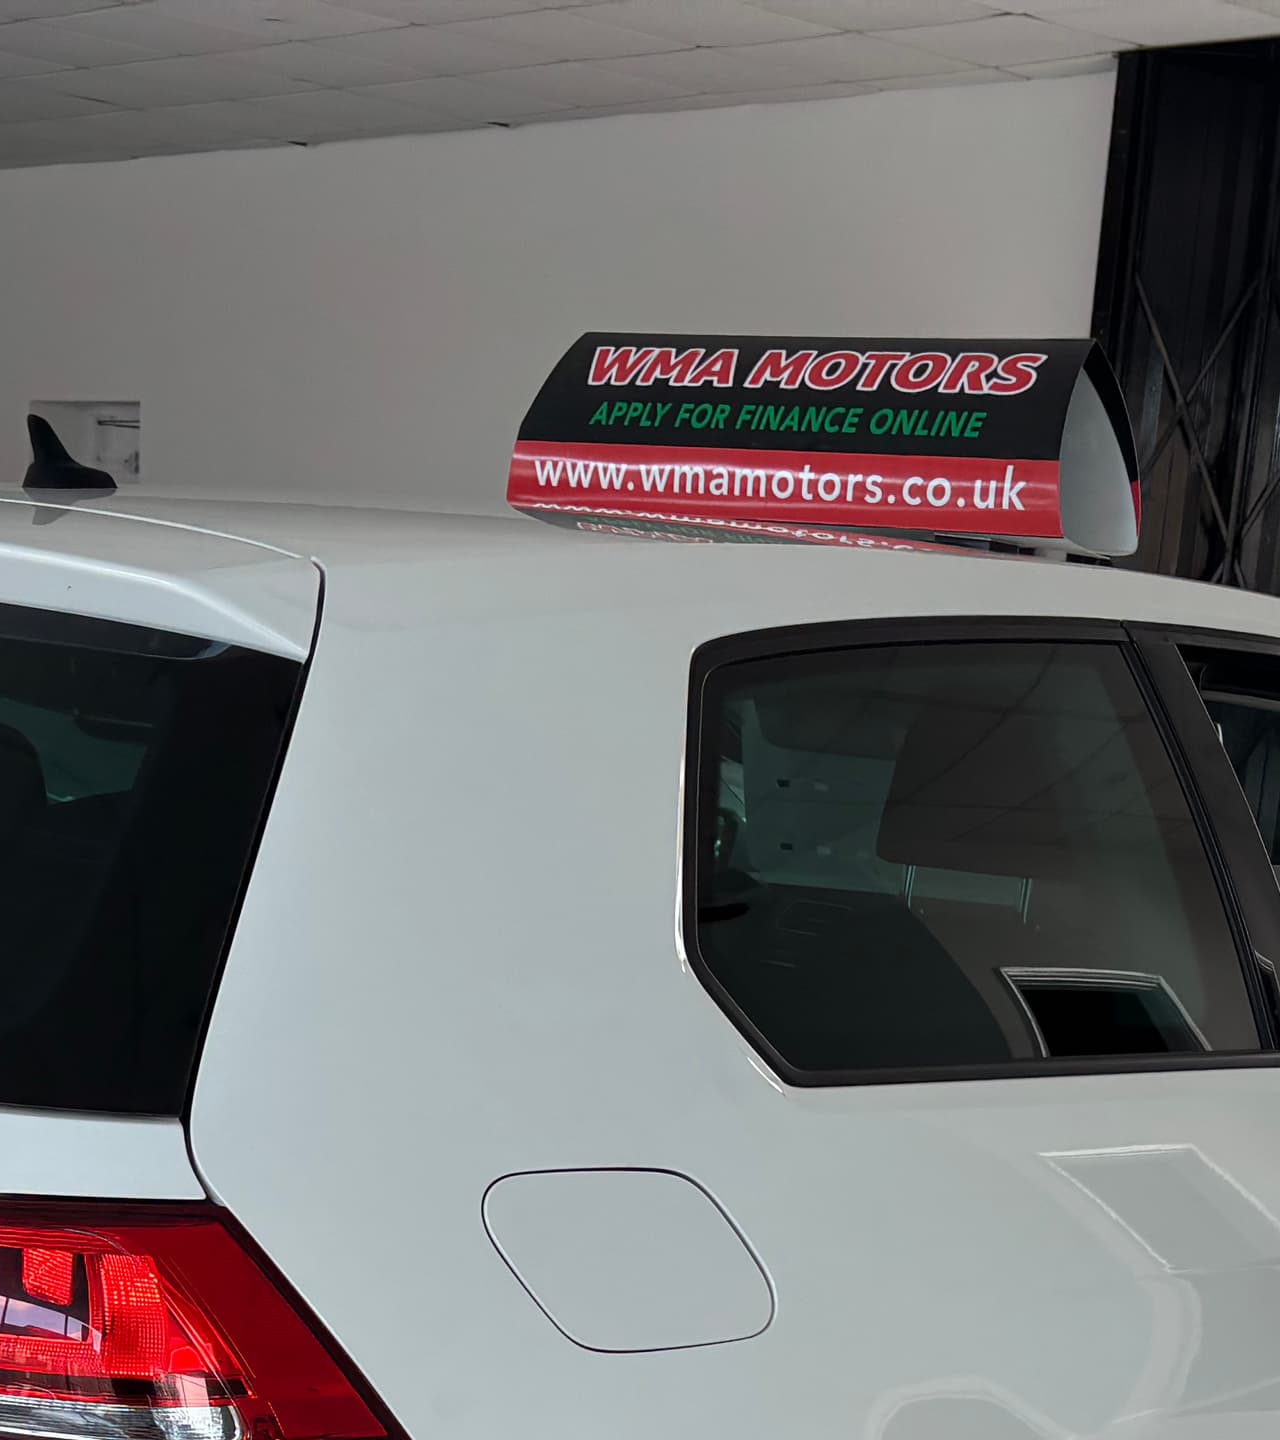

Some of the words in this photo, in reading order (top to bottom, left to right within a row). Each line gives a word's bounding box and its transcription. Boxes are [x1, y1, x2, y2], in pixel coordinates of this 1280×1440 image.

[588, 346, 738, 388] WMA
[743, 350, 1049, 395] MOTORS
[589, 401, 672, 429] APPLY
[674, 403, 732, 430] FOR
[735, 404, 864, 435] FINANCE
[869, 407, 987, 438] ONLINE
[534, 458, 1027, 511] www.wmamotors.co.uk
